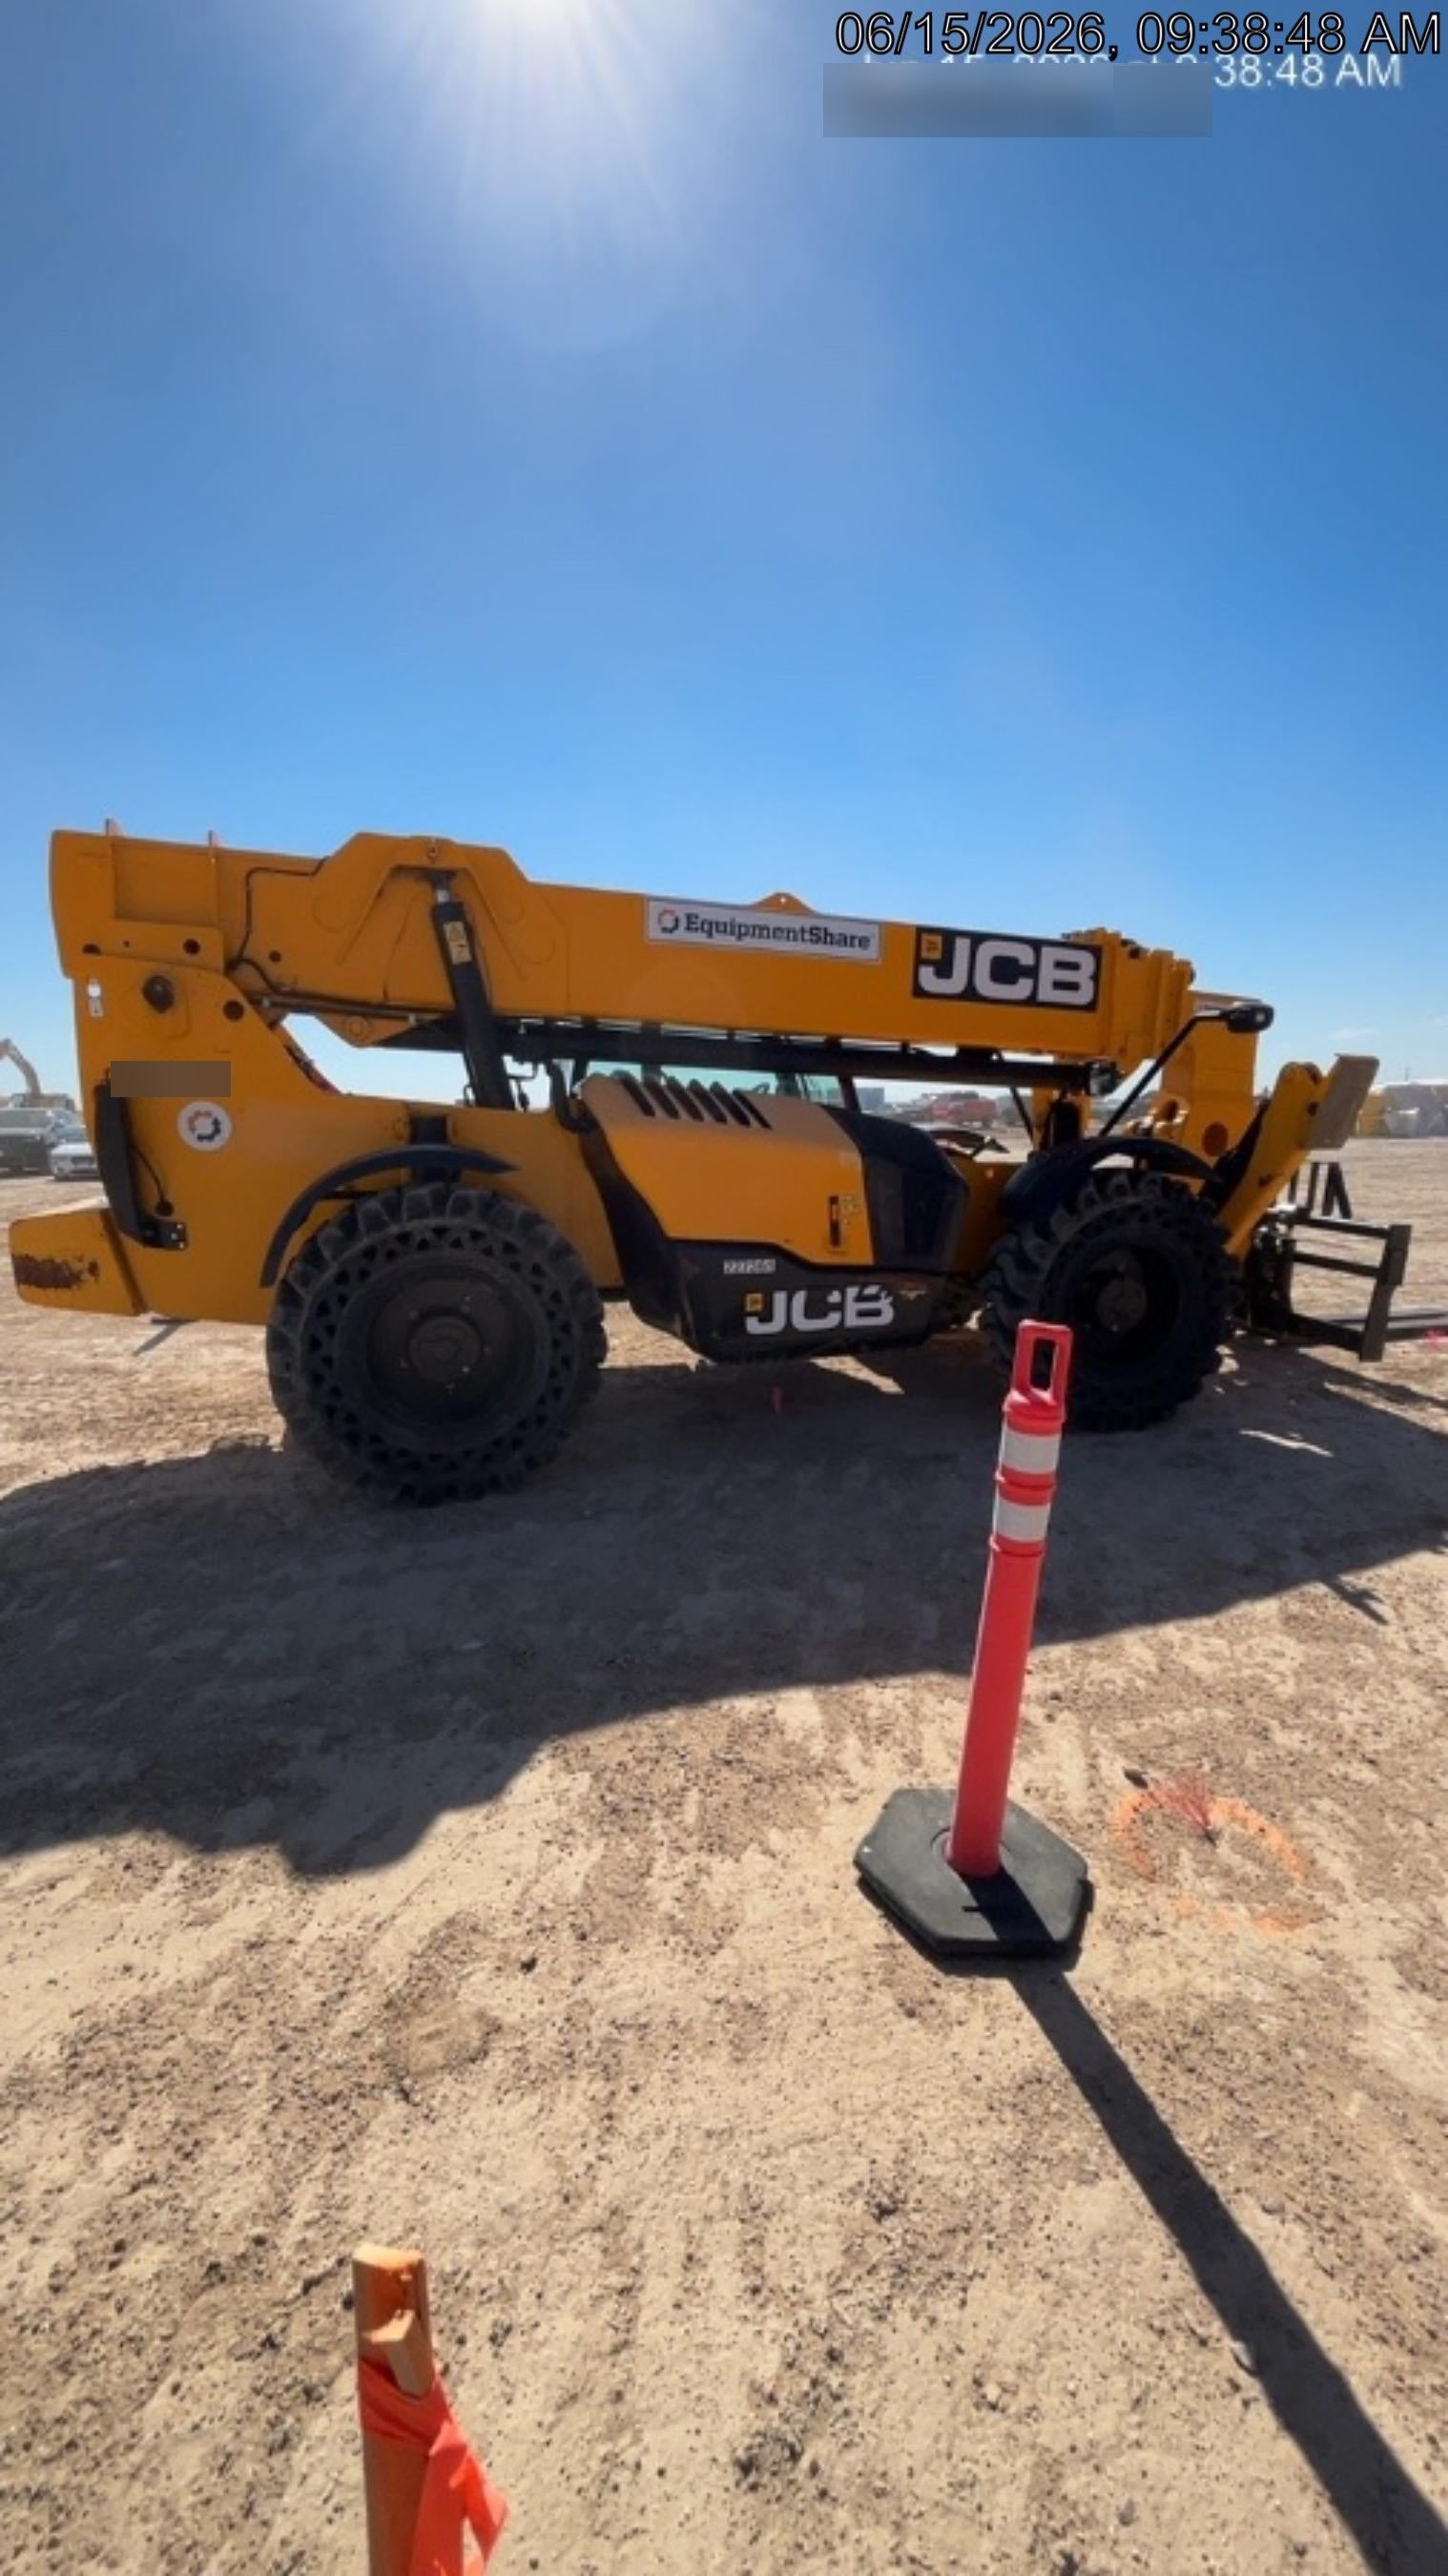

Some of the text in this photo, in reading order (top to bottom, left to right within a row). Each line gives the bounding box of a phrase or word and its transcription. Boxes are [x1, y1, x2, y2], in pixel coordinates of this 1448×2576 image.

[684, 912, 872, 950] EquipmentShare
[918, 936, 1098, 1007] JCB
[745, 1285, 895, 1336] JCB
